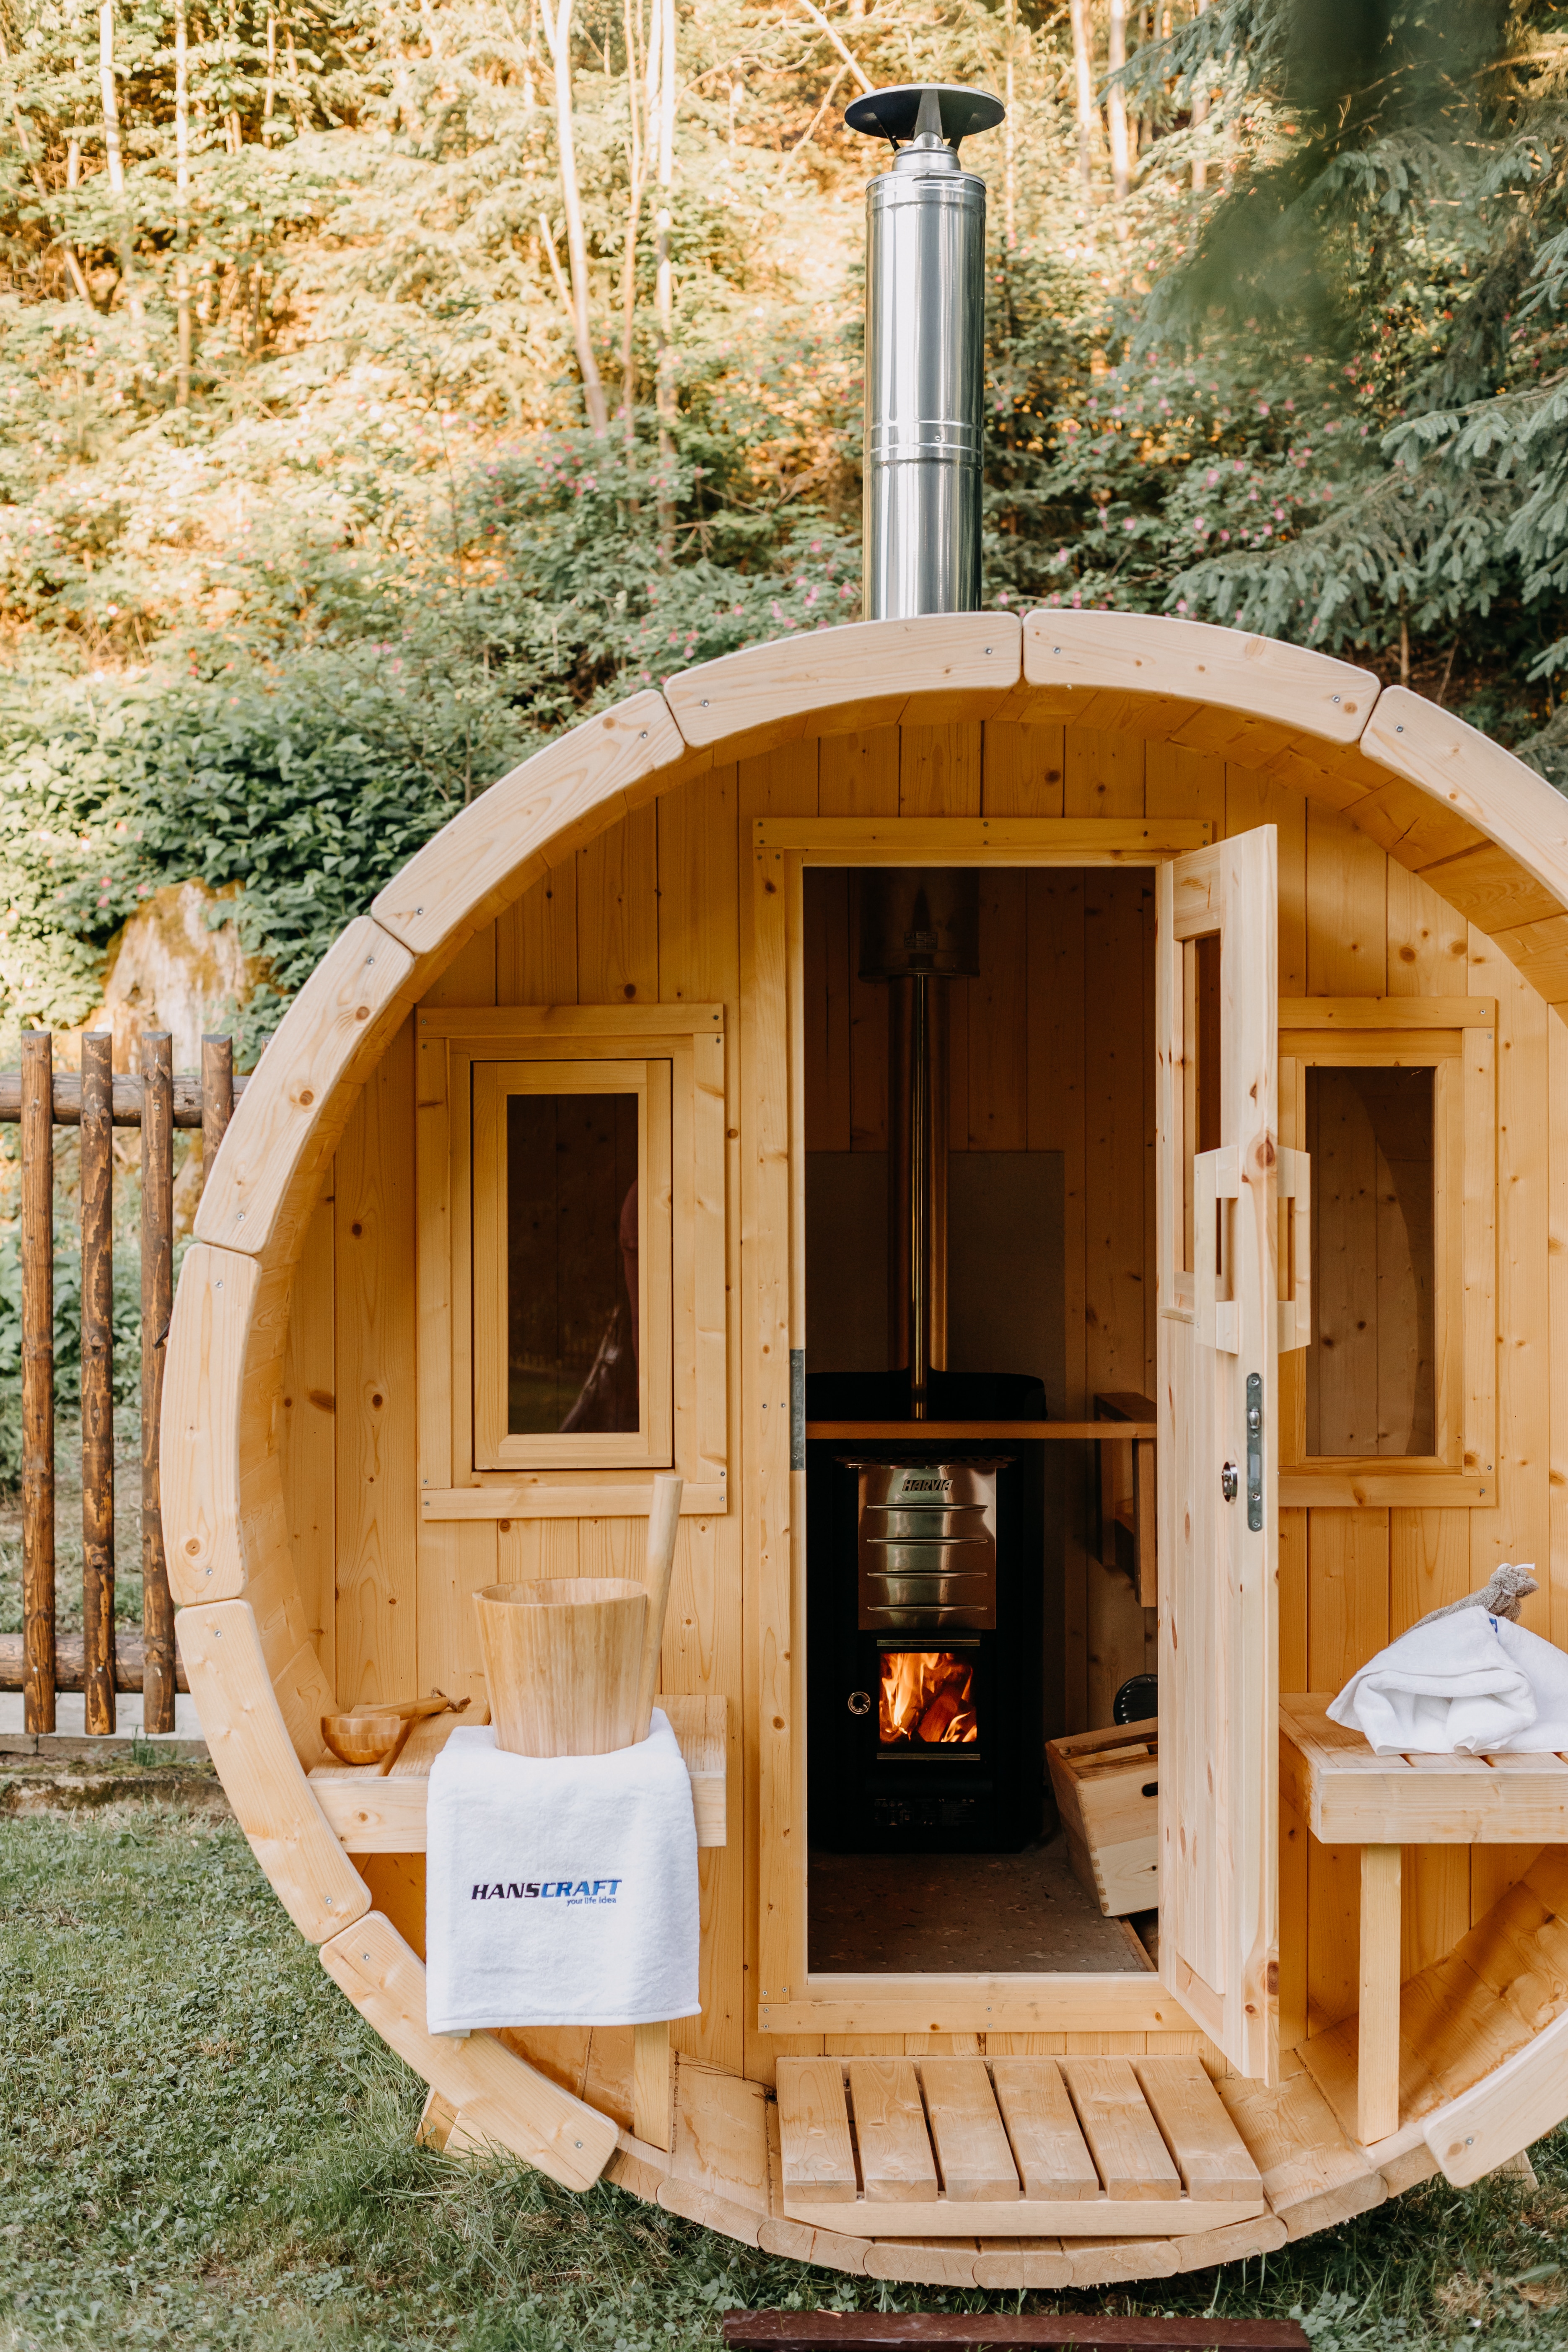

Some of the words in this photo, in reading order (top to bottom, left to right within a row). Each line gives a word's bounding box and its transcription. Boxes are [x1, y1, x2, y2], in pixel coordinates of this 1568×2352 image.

[902, 1479, 953, 1491] HARVIA
[471, 1879, 622, 1900] HANSCRAFT
[567, 1899, 583, 1907] your
